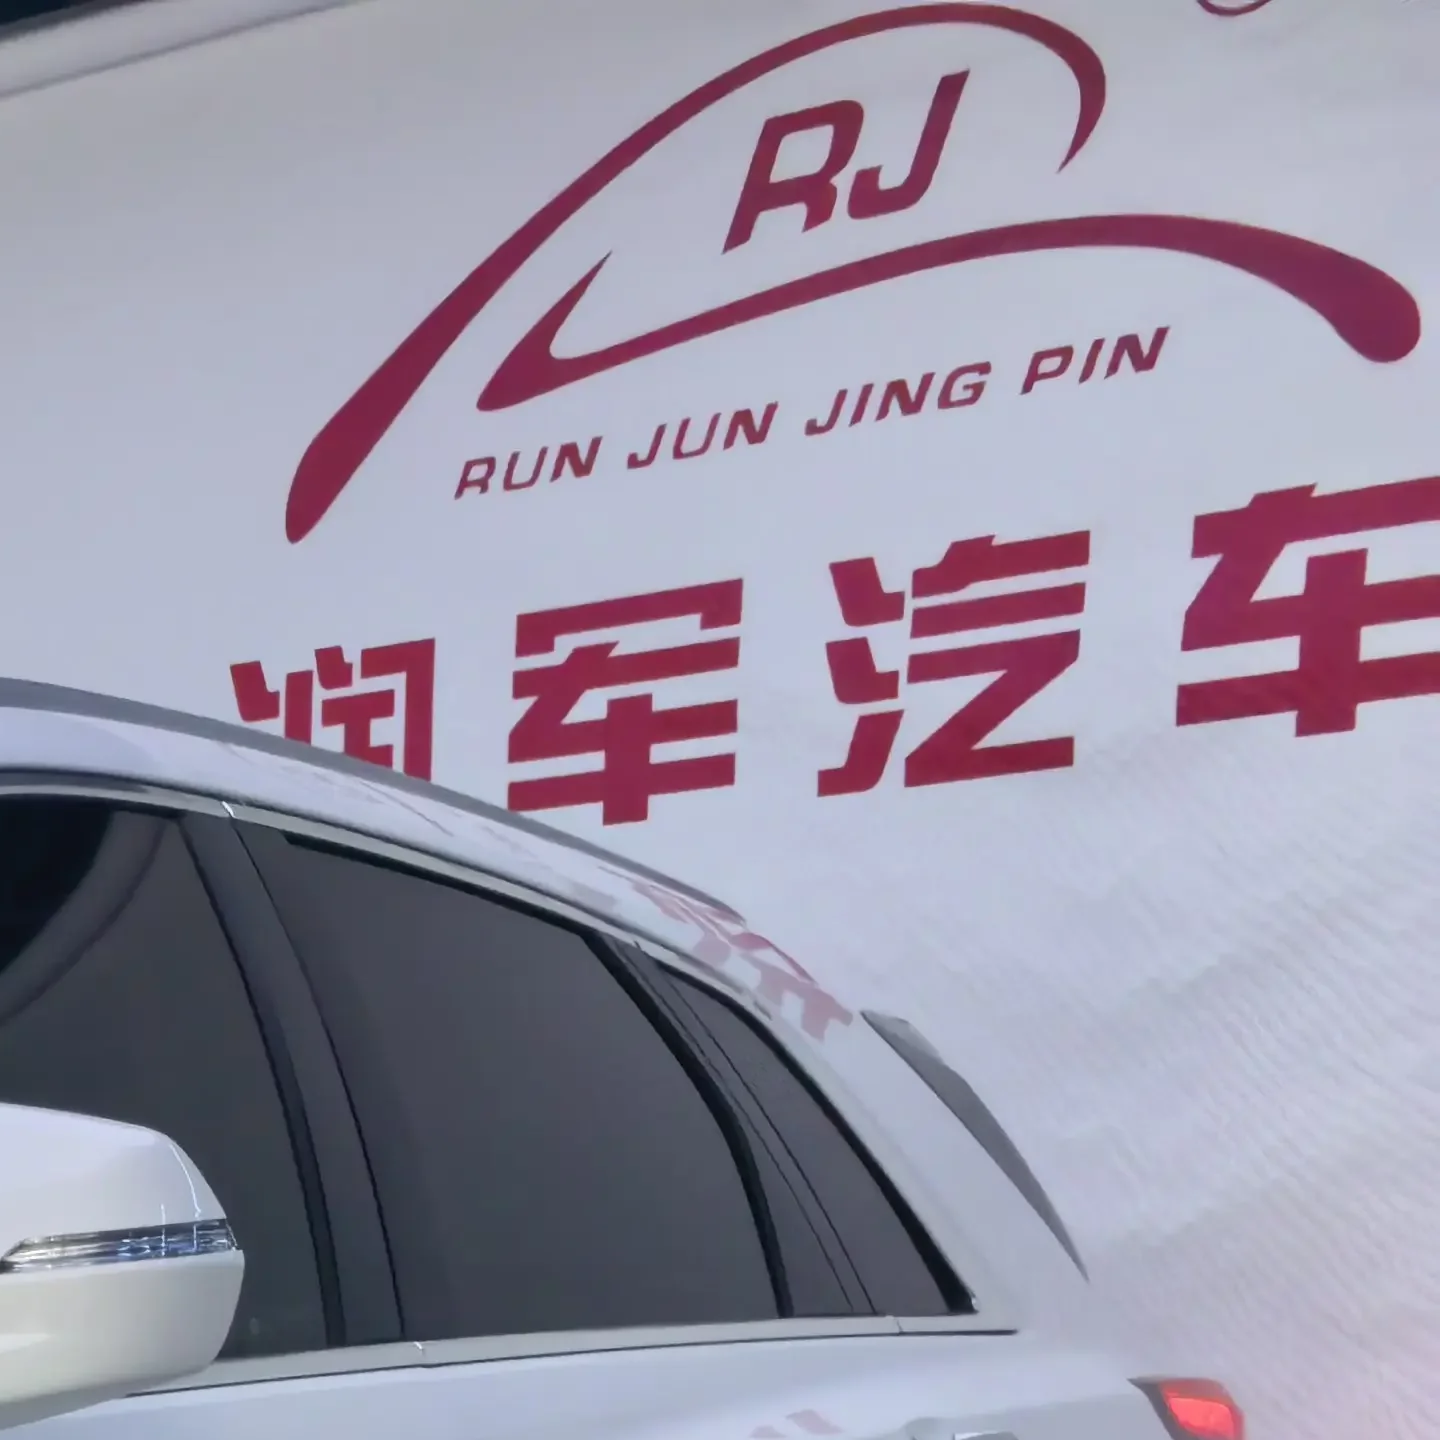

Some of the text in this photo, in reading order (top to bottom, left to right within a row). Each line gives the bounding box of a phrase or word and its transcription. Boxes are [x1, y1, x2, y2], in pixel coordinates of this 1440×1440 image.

[724, 69, 970, 254] RJ
[455, 326, 1170, 499] RUN JUN JING PIN
[230, 475, 1440, 826] 润军汽车
